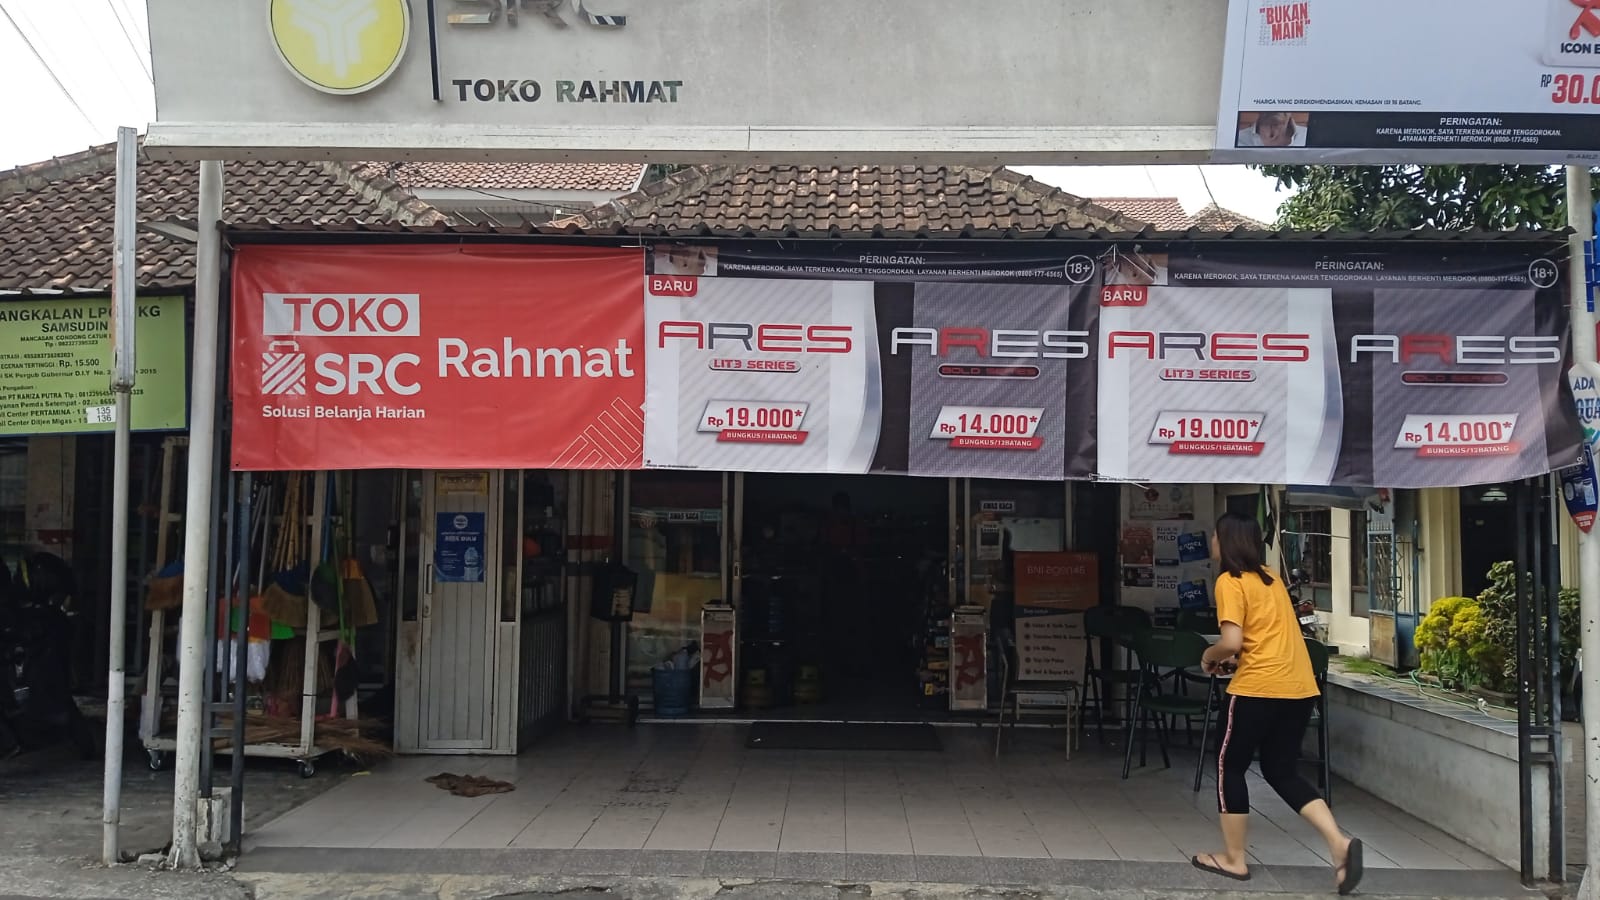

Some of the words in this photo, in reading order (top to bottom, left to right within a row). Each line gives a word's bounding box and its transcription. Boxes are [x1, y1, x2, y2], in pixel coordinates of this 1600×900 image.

[1560, 42, 1591, 54] ICON
[1541, 74, 1552, 88] RP
[452, 78, 541, 102] TOKO
[556, 80, 683, 103] RAHMAT
[1440, 117, 1503, 126] PERINGATAN:
[1455, 128, 1484, 136] TERKENA
[1428, 135, 1460, 143] BERHENTI
[859, 255, 926, 265] PERINGATAN:
[724, 263, 750, 271] KARENA
[948, 269, 981, 277] BERHENTI
[1069, 263, 1091, 274] 18+
[1315, 261, 1385, 271] PERINGATAN:
[1532, 267, 1554, 278] 18+
[1375, 274, 1407, 282] LAYANAN
[1443, 275, 1477, 283] MEROKOK
[653, 280, 693, 292] BARU
[1103, 290, 1143, 302] BARU
[89, 307, 113, 319] LP
[138, 306, 161, 318] KG
[283, 296, 409, 333] TOKO
[42, 321, 109, 333] SAMSUDIN
[658, 321, 853, 353] ARES
[890, 327, 1090, 359] ARES
[1107, 331, 1310, 362] ARES
[1350, 334, 1561, 365] ARES
[438, 337, 634, 378] Rahmat
[59, 360, 72, 369] Rp.
[75, 359, 100, 367] 15.500
[713, 359, 742, 369] LIT3
[747, 360, 796, 370] SERIES
[314, 353, 421, 396] SRC
[1164, 369, 1194, 379] LIT3
[1199, 370, 1251, 380] SERIES
[1573, 376, 1596, 391] ADA
[31, 409, 71, 417] PERTAMINA
[96, 407, 111, 415] 135
[262, 405, 311, 419] Solusi
[314, 405, 372, 421] Belanja
[375, 406, 426, 419] Harian
[707, 416, 724, 427] Rp
[940, 424, 956, 434] Rp
[1159, 428, 1175, 439] Rp
[1405, 432, 1422, 443] Rp
